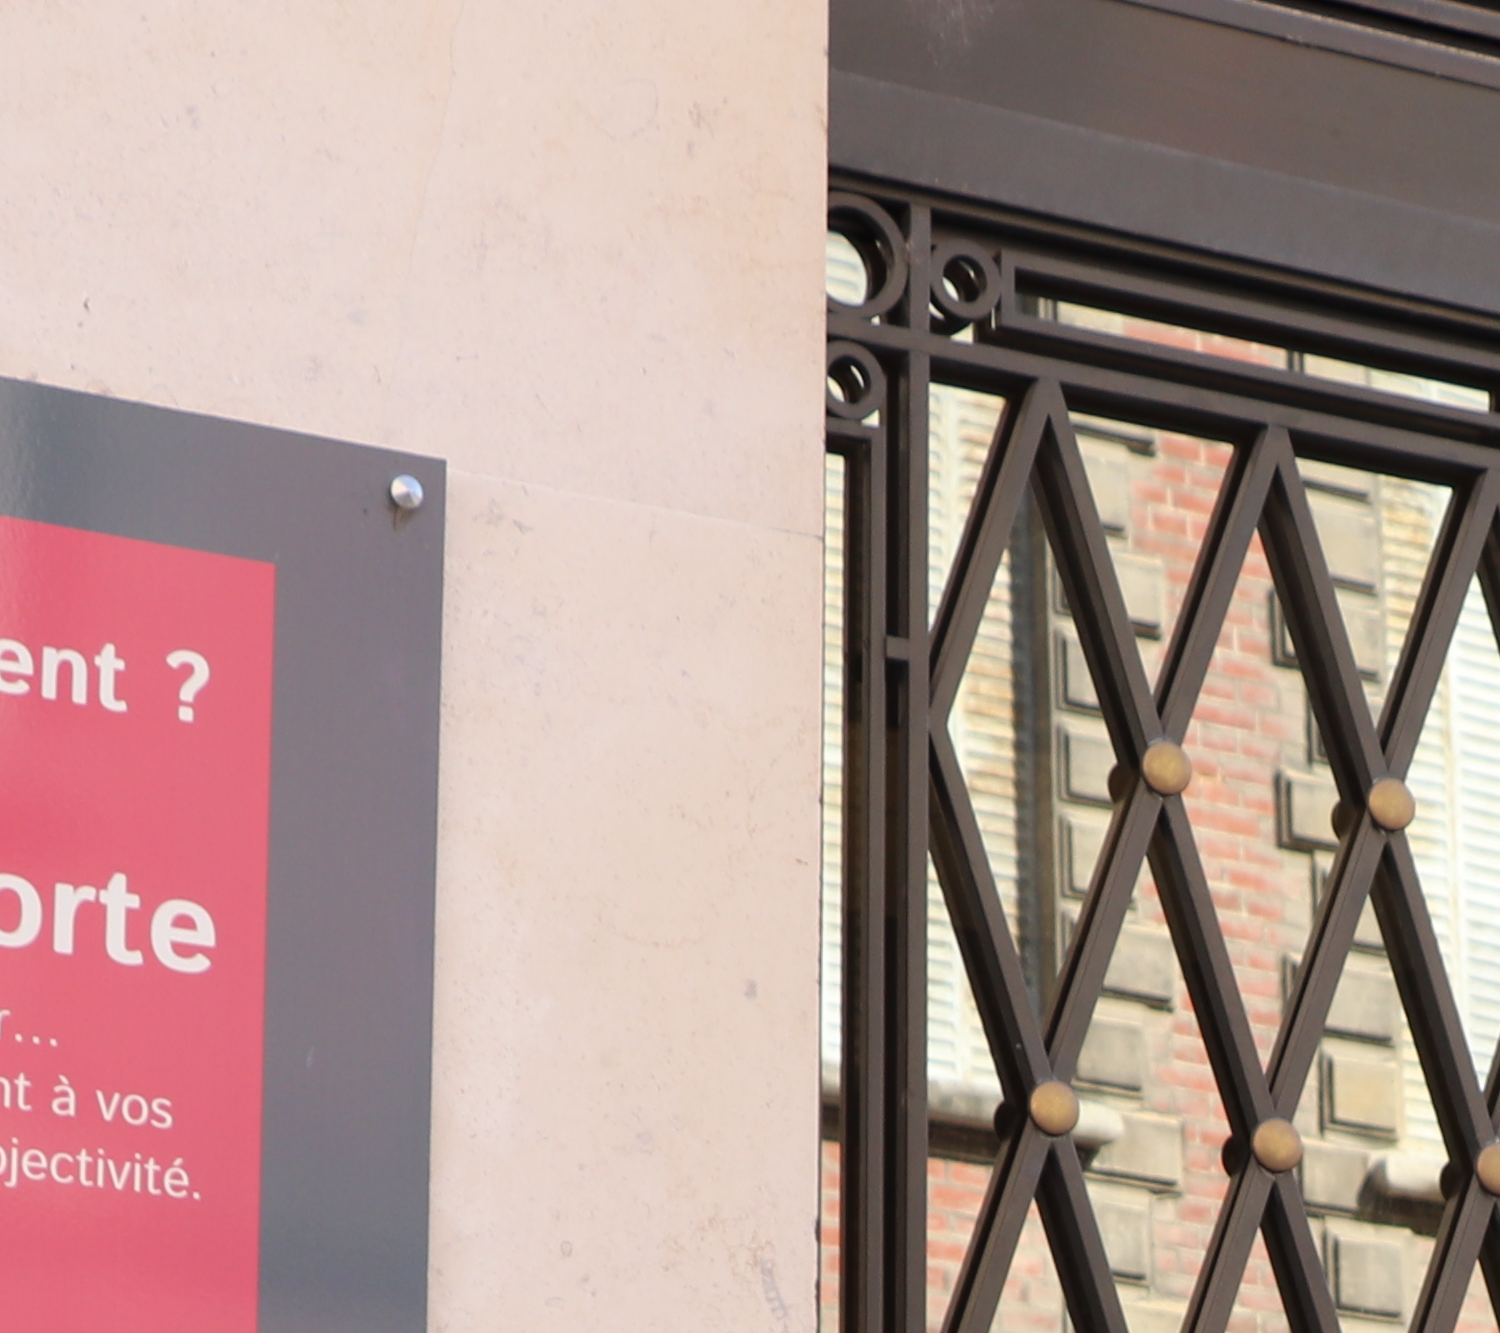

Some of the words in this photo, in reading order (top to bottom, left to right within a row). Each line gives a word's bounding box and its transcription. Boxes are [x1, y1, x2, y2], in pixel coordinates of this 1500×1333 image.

[164, 648, 211, 724] ?
[50, 1073, 77, 1118] à
[94, 1088, 174, 1130] vos
